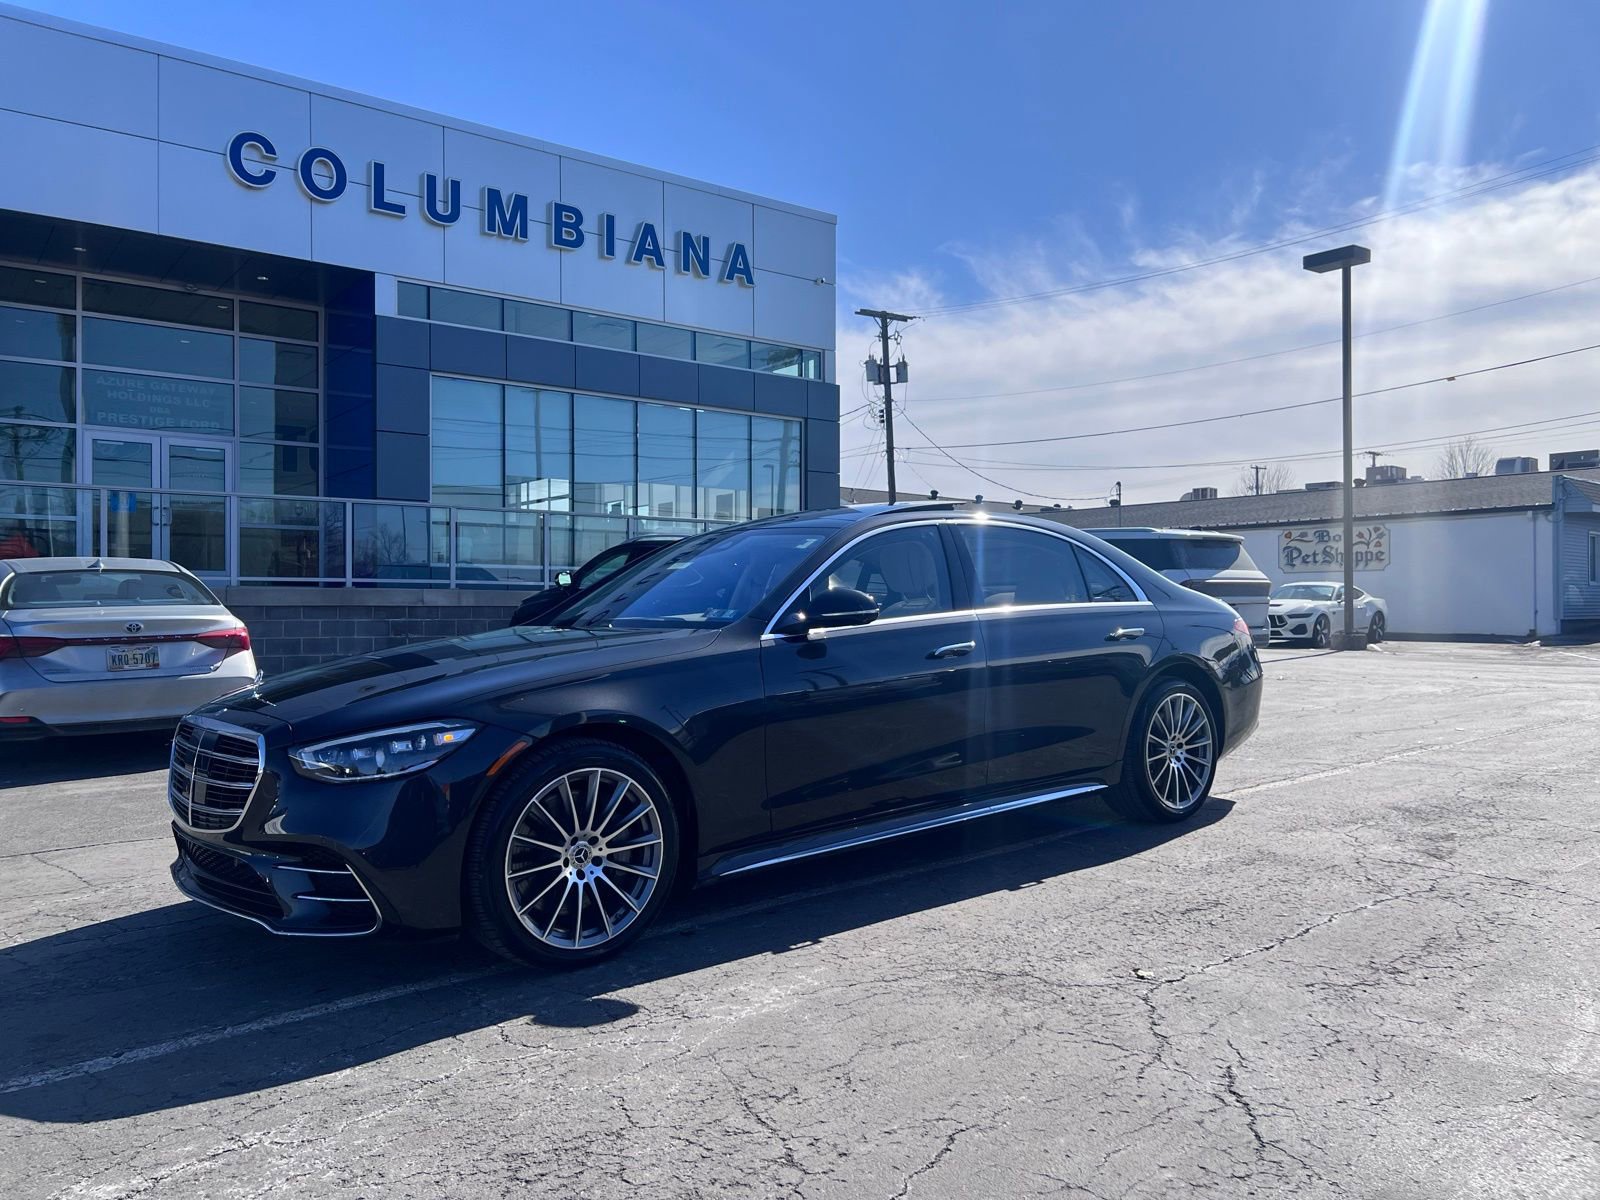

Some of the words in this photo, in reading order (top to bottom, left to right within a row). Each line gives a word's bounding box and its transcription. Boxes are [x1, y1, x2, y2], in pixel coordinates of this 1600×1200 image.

[226, 131, 755, 286] COLUMBIANA
[96, 375, 145, 390] AZURE
[150, 382, 216, 395] GATEWAY
[107, 390, 182, 406] HOLDINGS
[186, 397, 211, 408] LLC
[97, 412, 175, 428] PRESTIGE
[180, 419, 220, 429] FORD
[1320, 544, 1386, 569] Shppe
